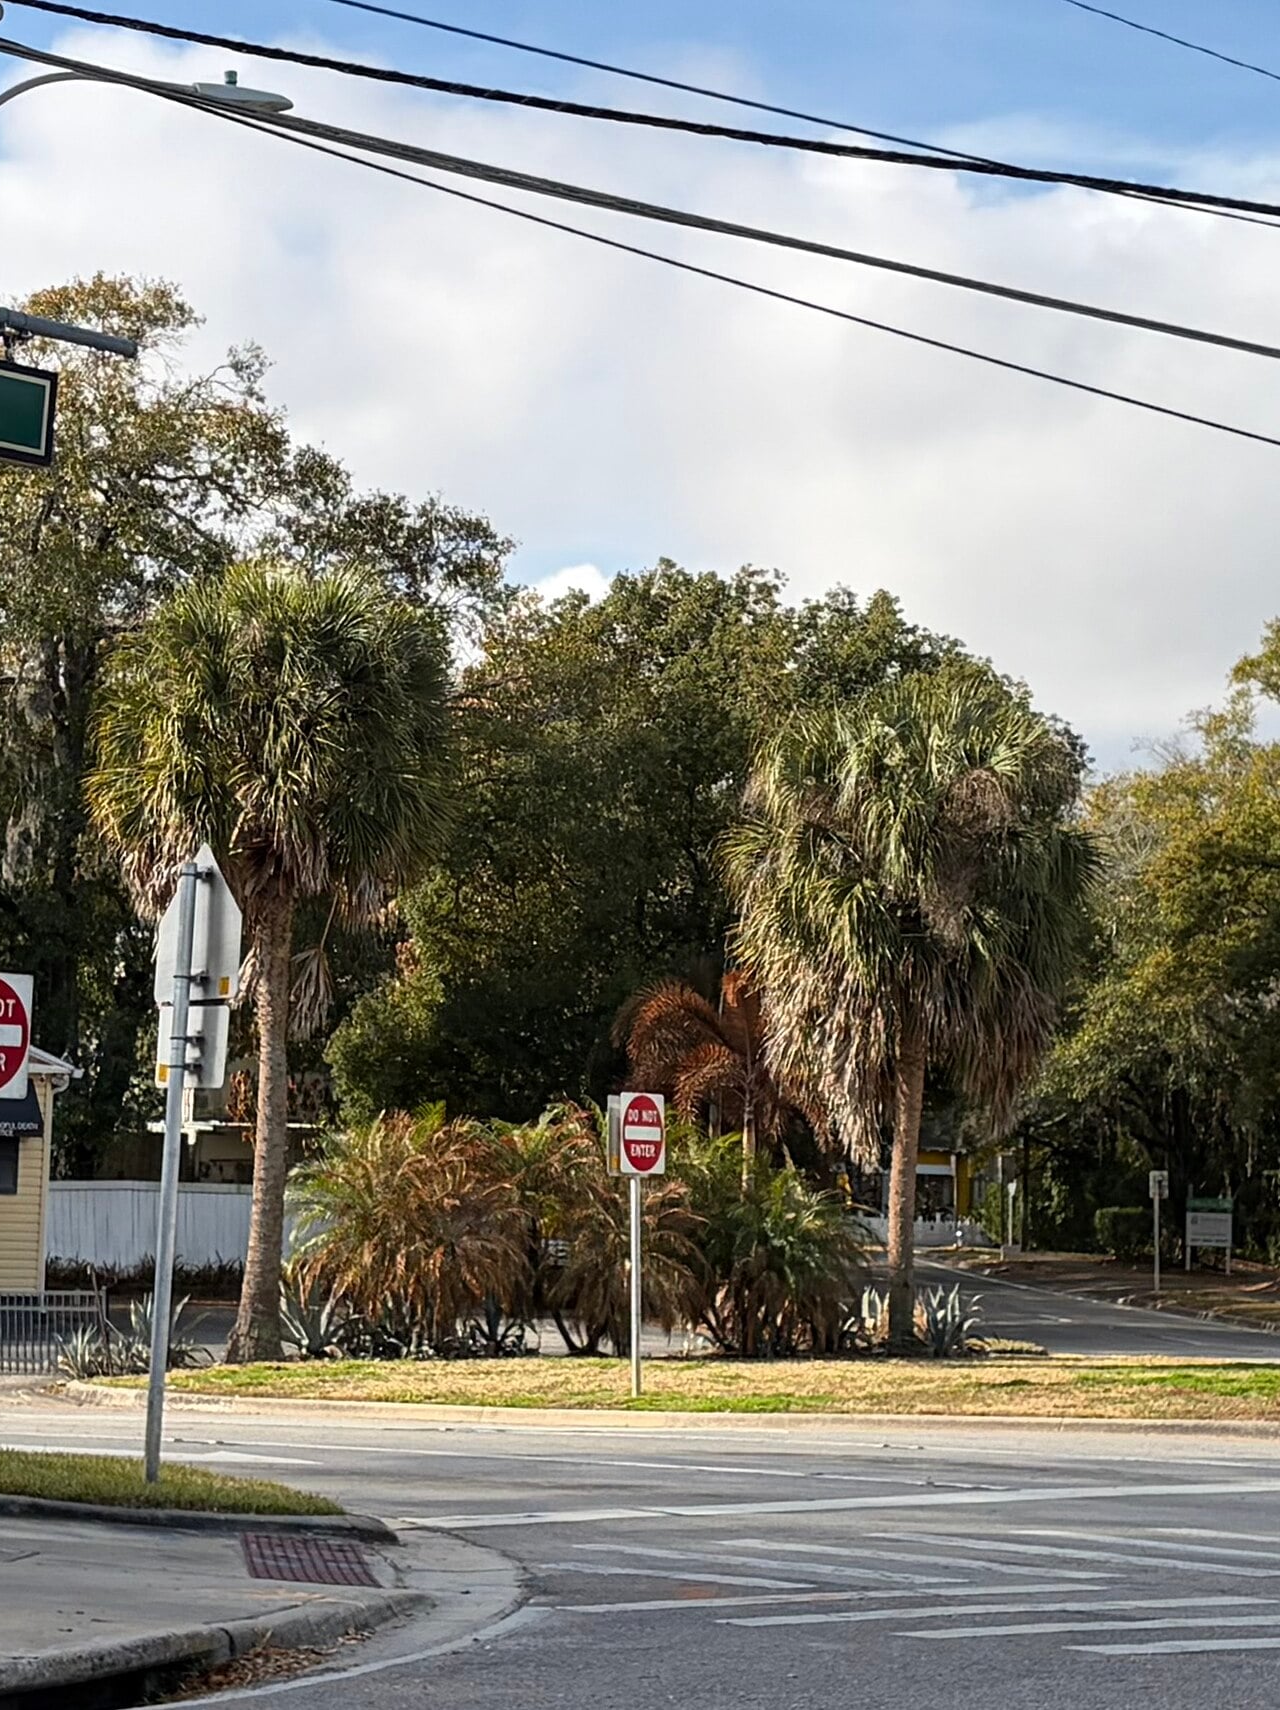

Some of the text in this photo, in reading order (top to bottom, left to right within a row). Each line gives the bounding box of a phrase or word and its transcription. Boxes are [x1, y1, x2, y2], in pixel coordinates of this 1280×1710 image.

[628, 1109, 657, 1123] DO NOT
[630, 1144, 656, 1158] ENTER
